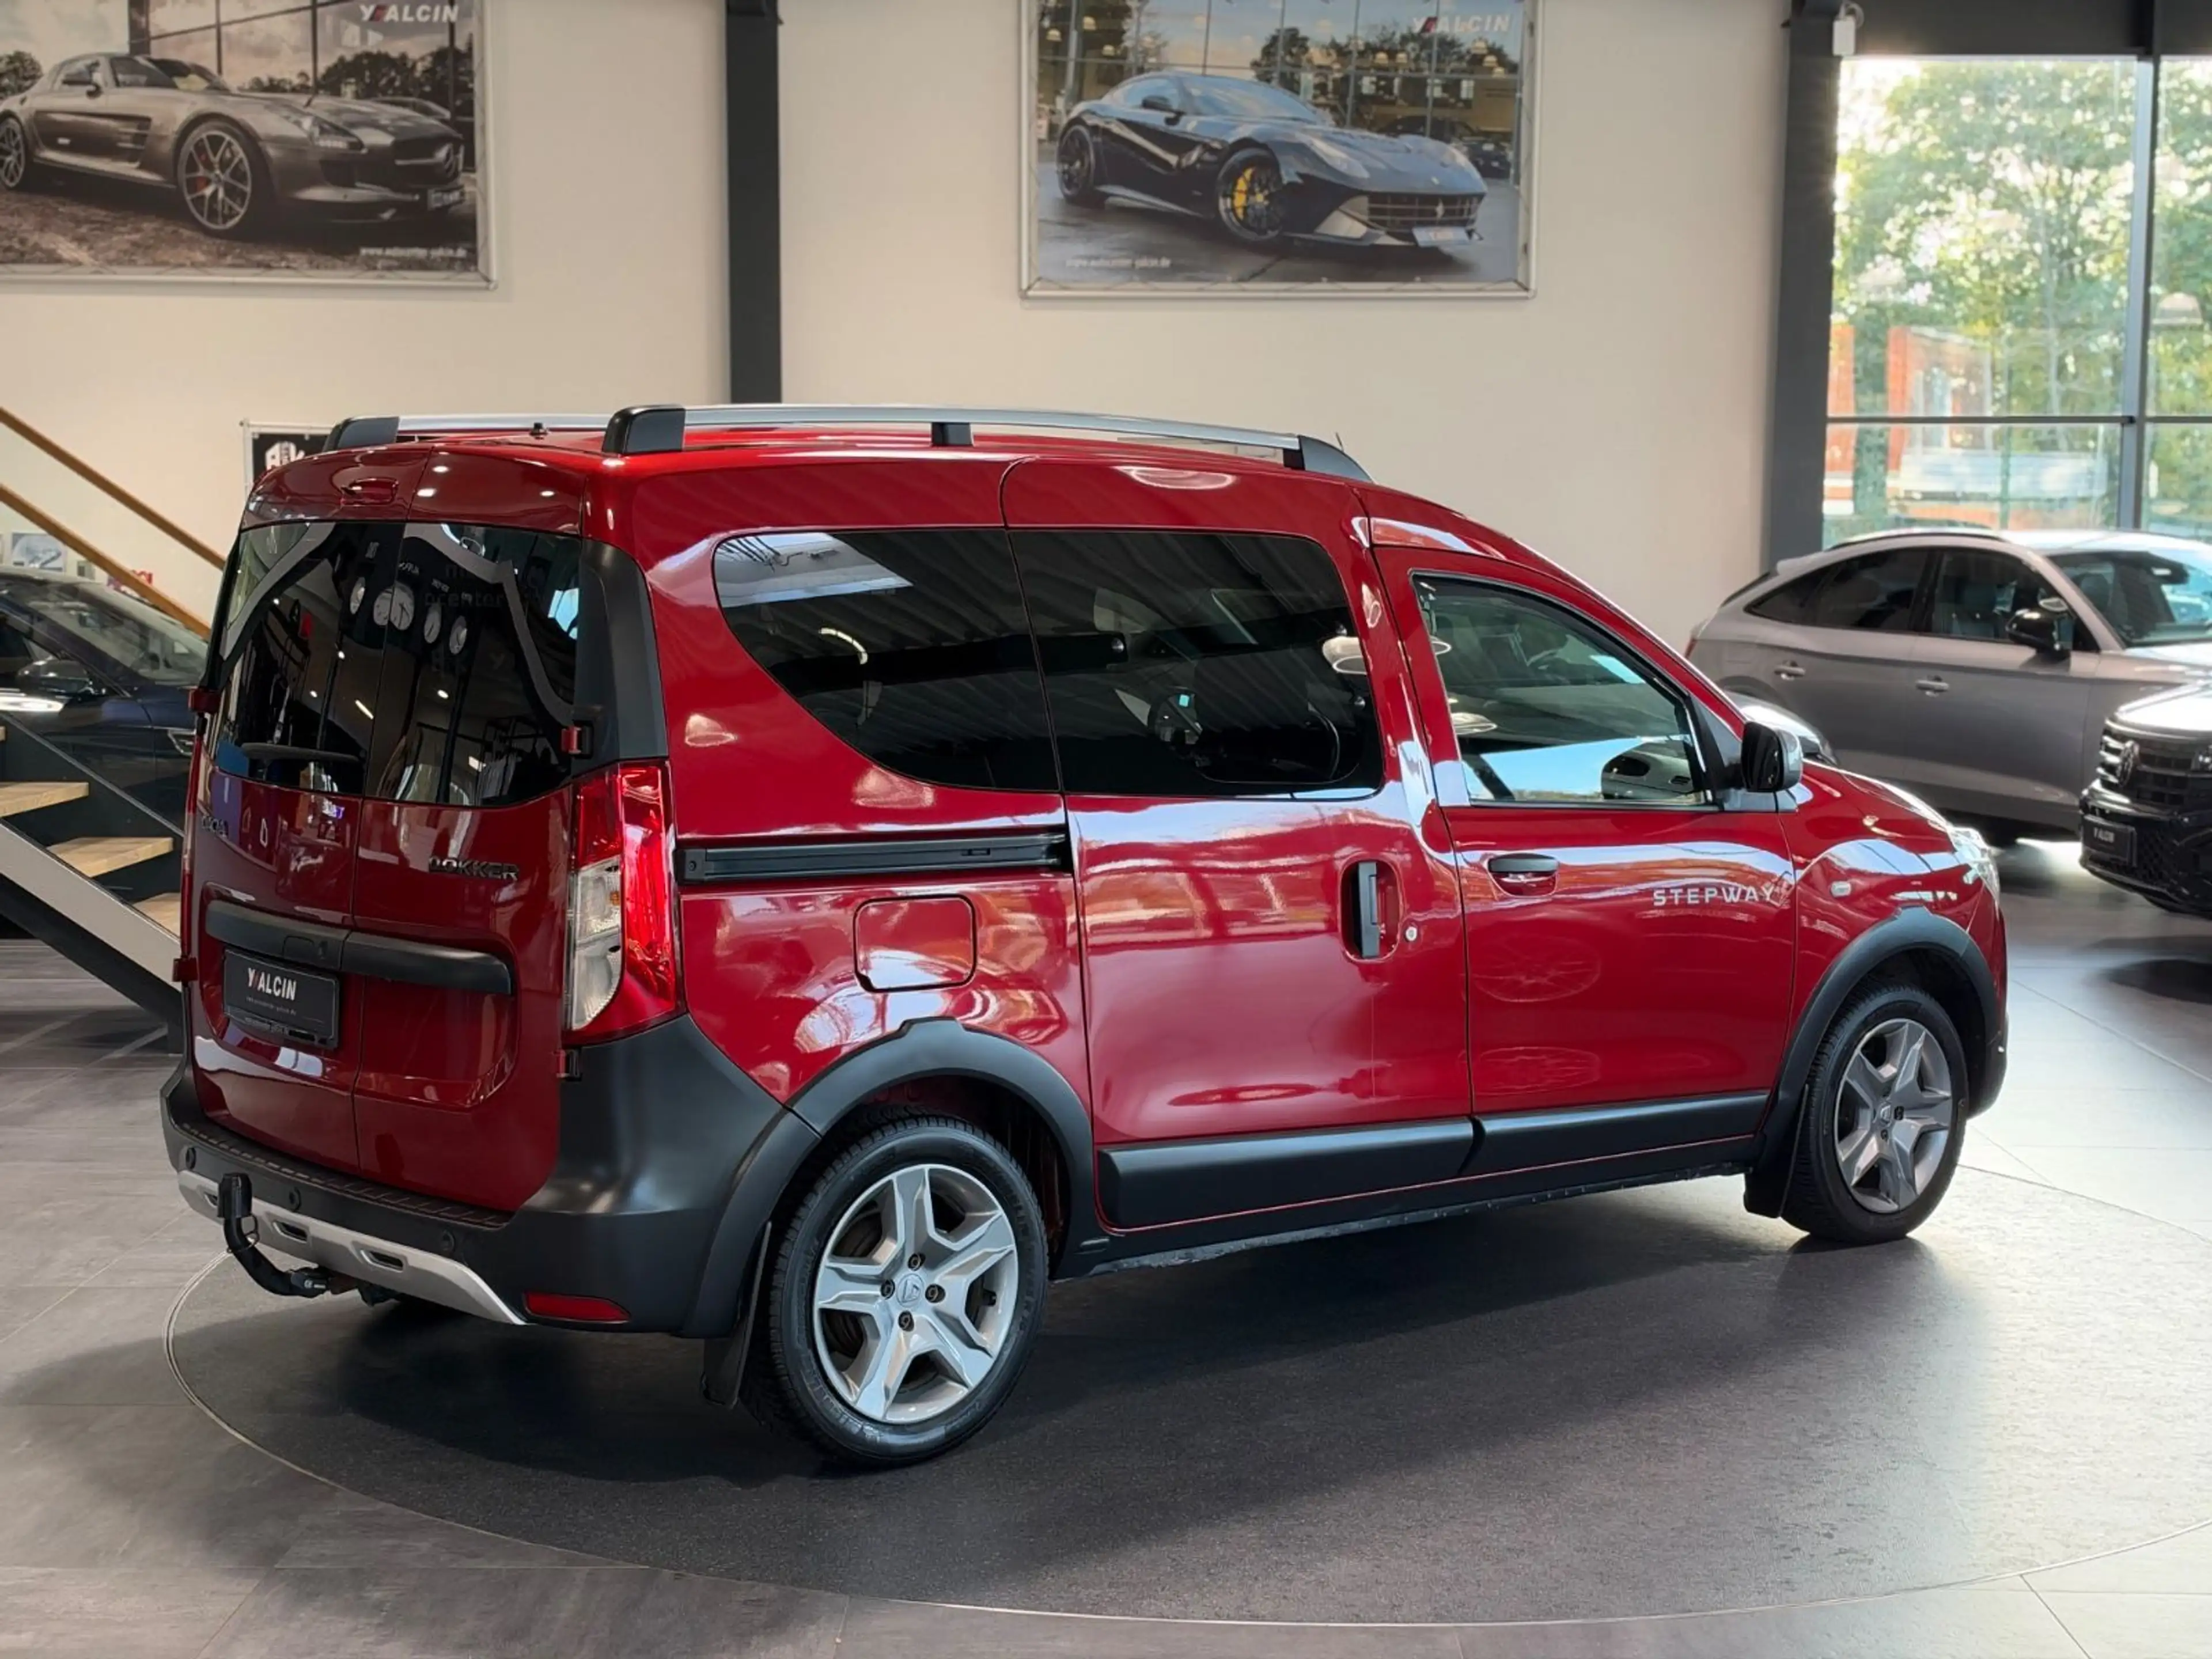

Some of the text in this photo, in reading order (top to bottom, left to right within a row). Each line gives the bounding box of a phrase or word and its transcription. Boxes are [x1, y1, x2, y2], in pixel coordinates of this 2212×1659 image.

[359, 4, 459, 23] YALCIN
[1653, 885, 1775, 907] STEPWAY
[248, 967, 297, 1001] YALCIN
